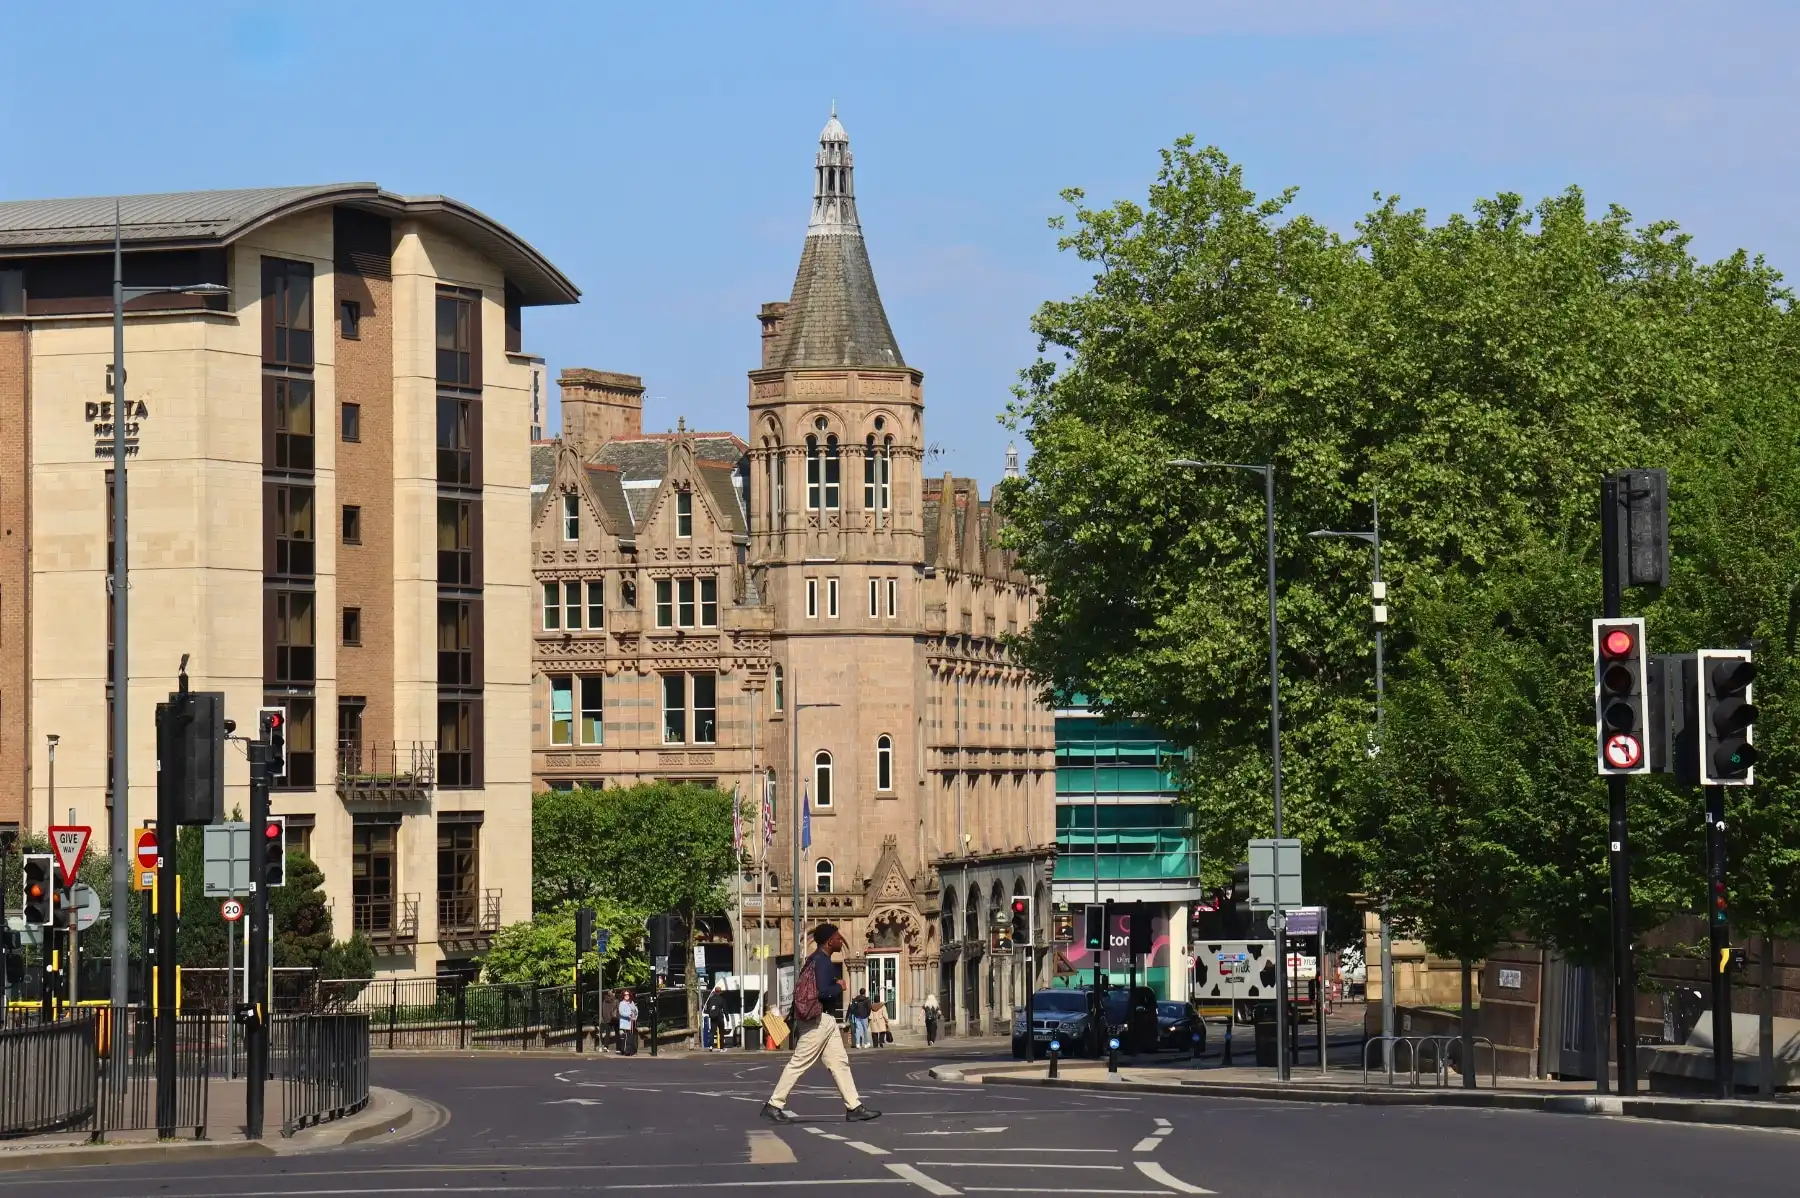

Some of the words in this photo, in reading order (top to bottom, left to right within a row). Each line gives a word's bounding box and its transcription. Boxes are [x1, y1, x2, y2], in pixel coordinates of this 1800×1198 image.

[86, 400, 148, 421] DETA
[94, 423, 139, 436] HOLS
[60, 833, 78, 844] GIVE
[225, 905, 240, 915] 20
